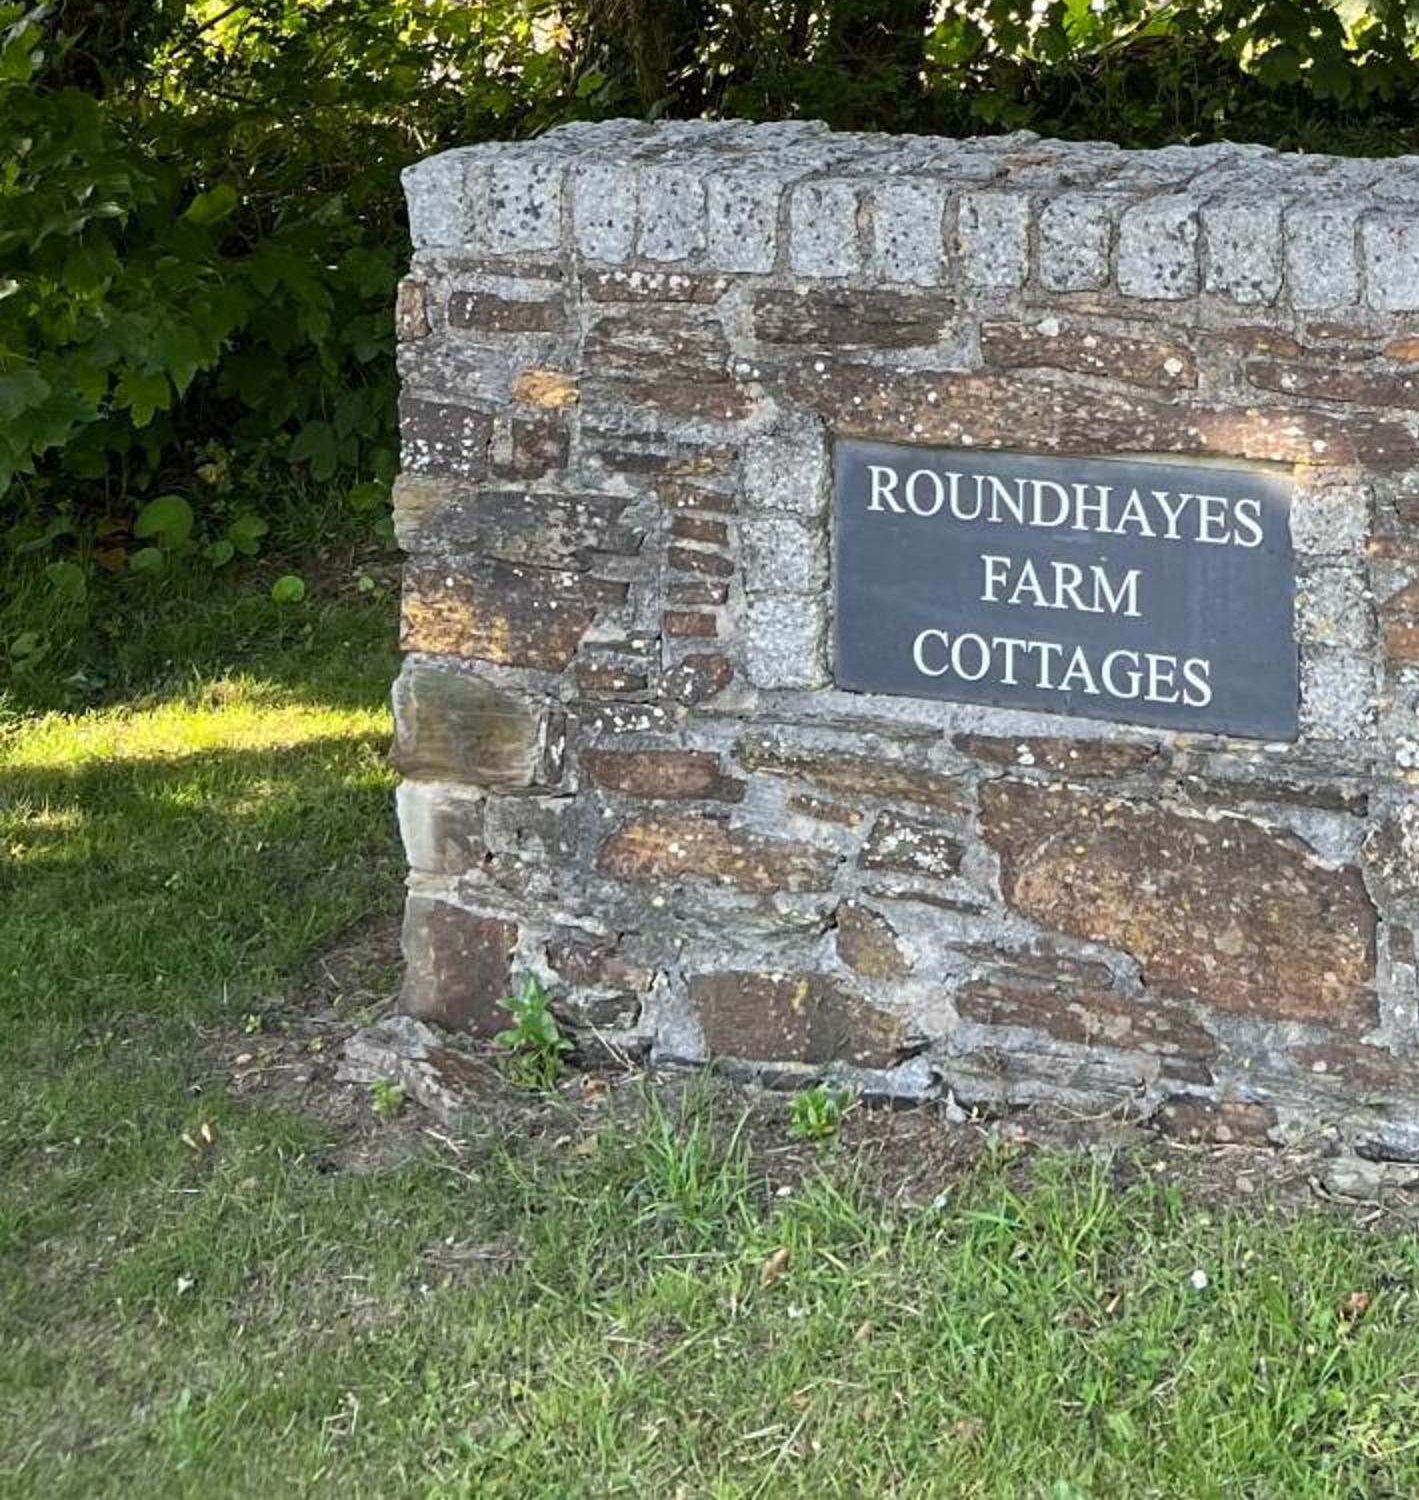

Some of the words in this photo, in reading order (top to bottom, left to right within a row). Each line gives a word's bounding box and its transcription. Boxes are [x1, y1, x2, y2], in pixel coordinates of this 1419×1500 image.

[867, 465, 1264, 548] ROUNDHAYES
[980, 555, 1142, 617] FARM
[912, 629, 1212, 707] COTTAGES
